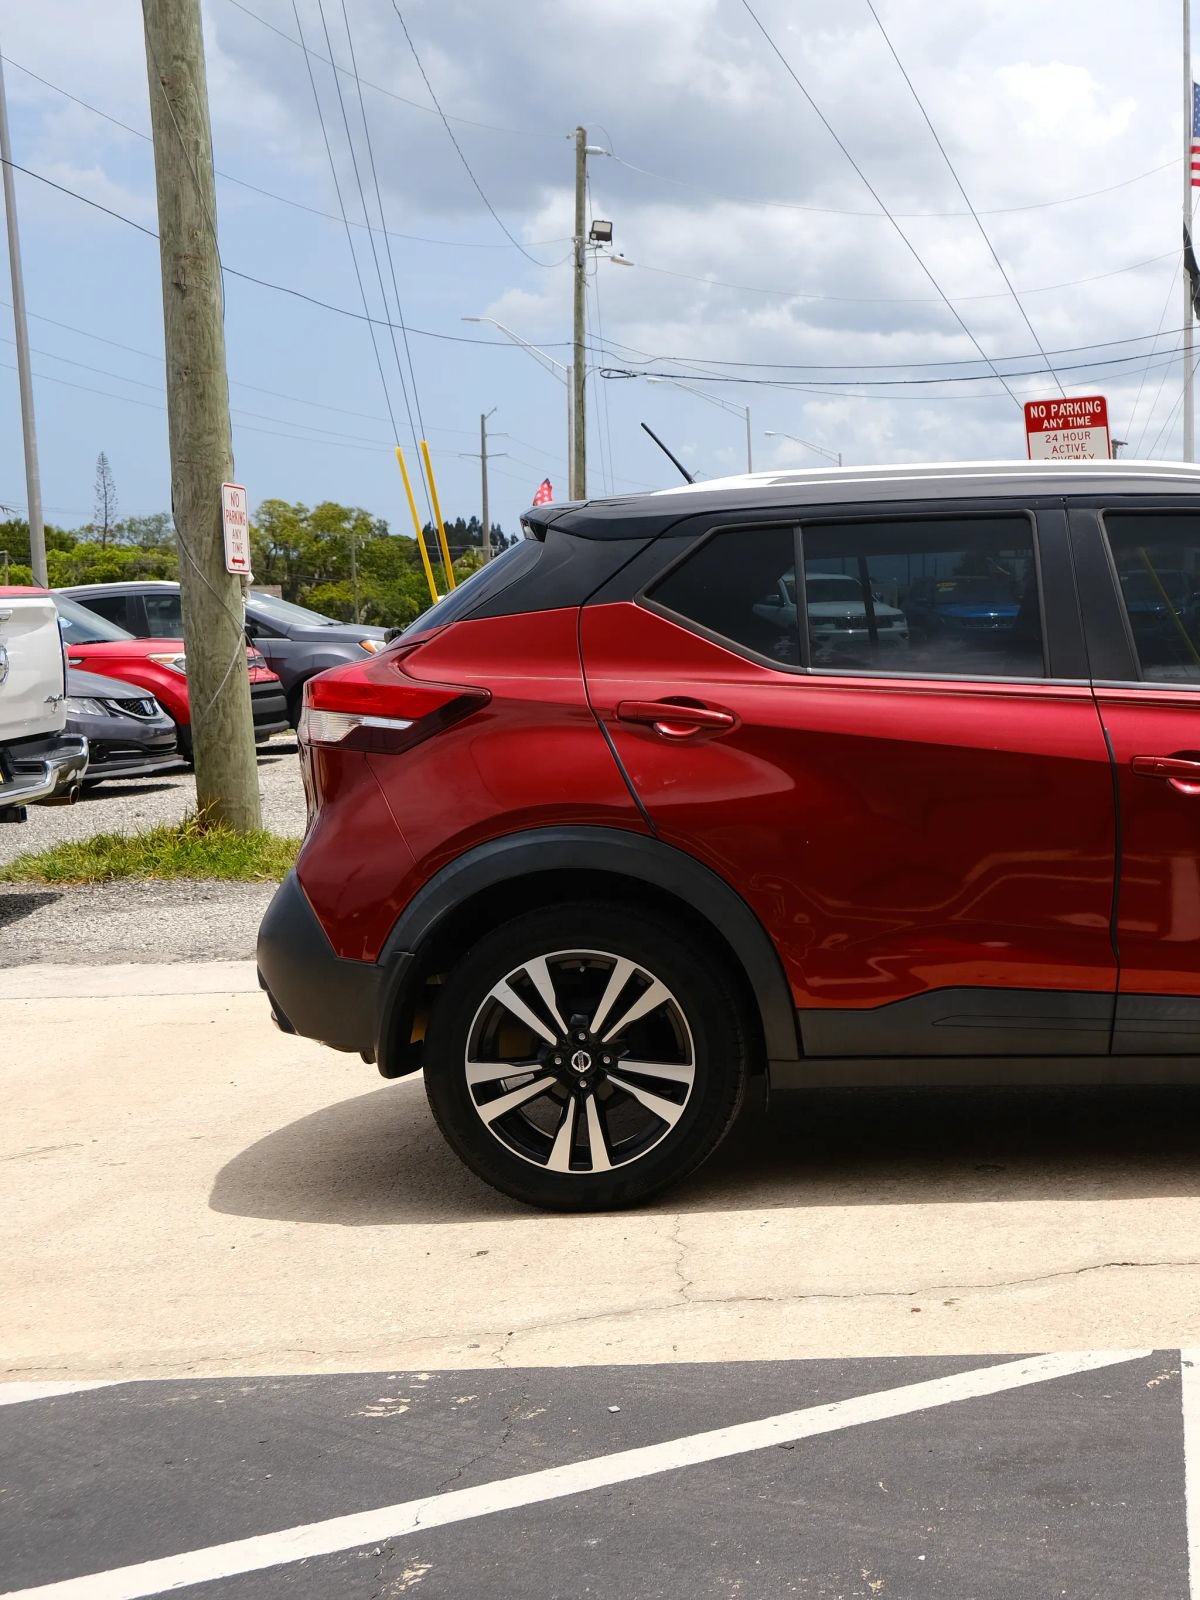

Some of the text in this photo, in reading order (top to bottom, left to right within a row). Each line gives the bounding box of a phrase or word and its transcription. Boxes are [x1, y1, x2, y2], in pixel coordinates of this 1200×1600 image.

[1030, 400, 1101, 418] NO PARKING
[1043, 416, 1091, 429] ANY TIME
[1045, 431, 1091, 443] 24 HOUR
[1052, 443, 1087, 454] ACTIVE
[230, 492, 240, 507] NO
[225, 509, 245, 526] PARKING
[232, 528, 241, 540] ANY
[232, 541, 243, 554] TIME
